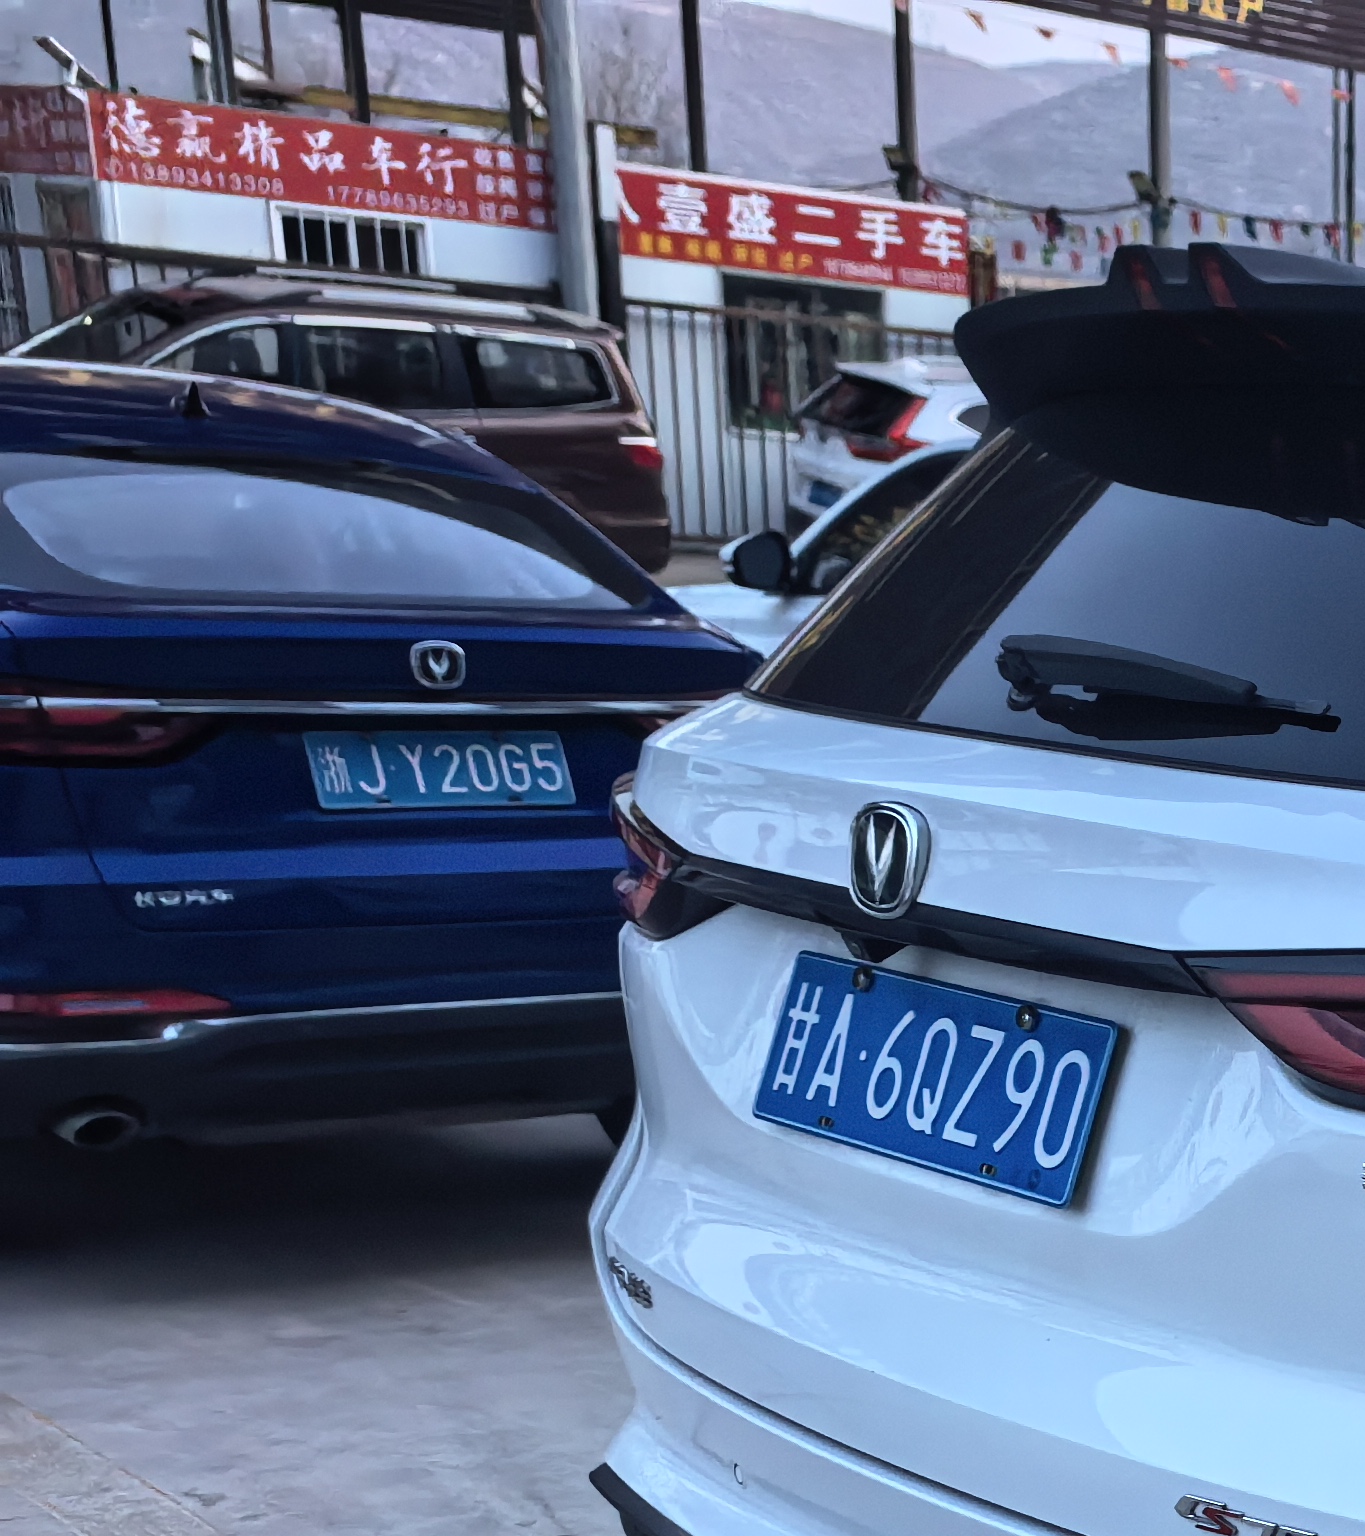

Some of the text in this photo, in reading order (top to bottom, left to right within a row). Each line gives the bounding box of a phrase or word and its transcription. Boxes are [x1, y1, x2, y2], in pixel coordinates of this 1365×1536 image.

[656, 182, 974, 268] 壹盛二手车
